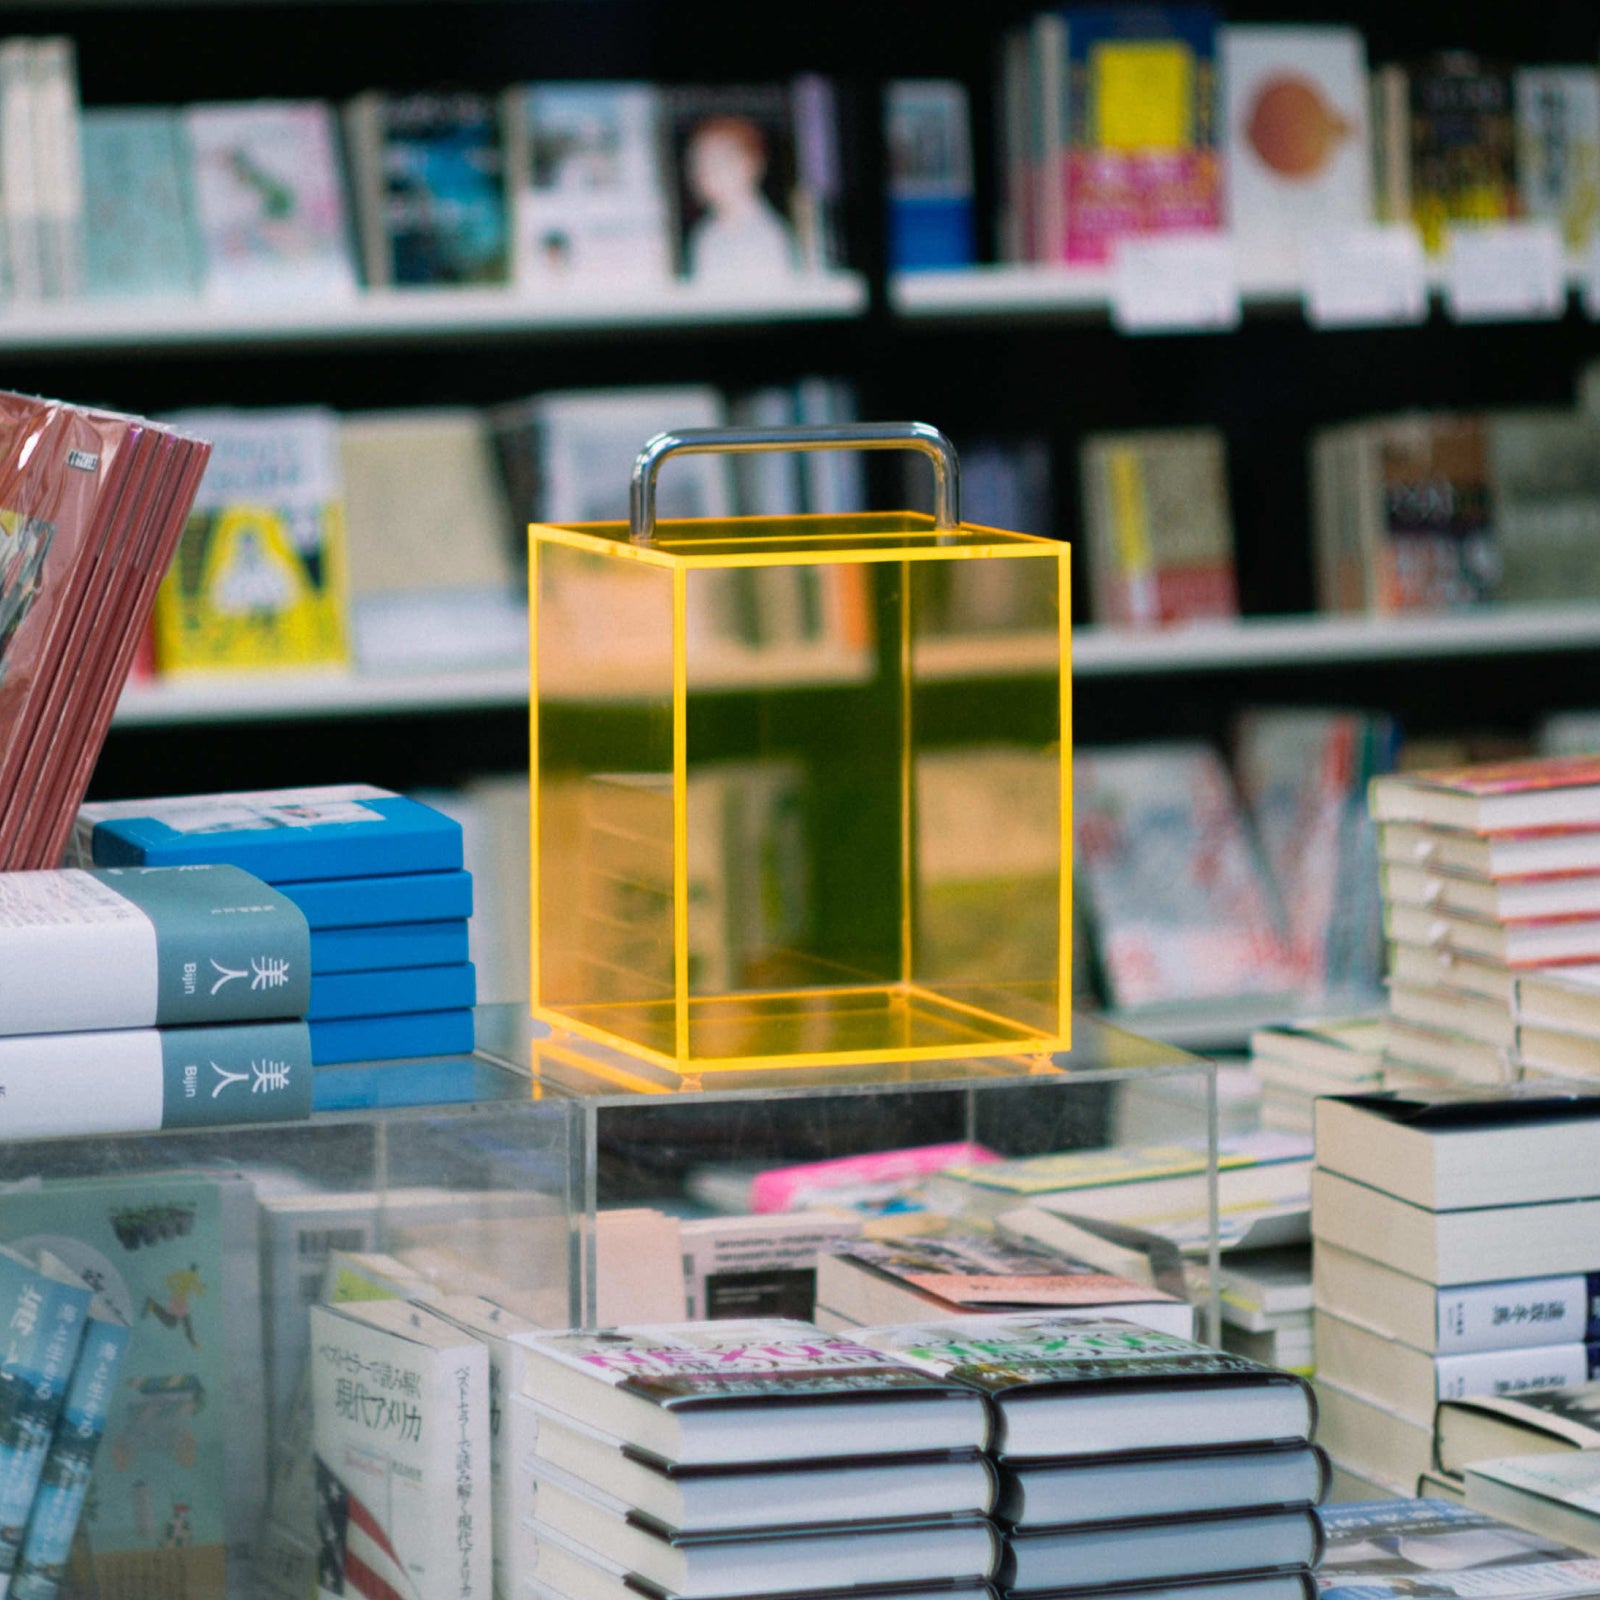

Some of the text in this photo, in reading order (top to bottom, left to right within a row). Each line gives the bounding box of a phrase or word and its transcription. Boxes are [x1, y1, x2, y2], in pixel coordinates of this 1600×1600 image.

[182, 962, 197, 995] Bijin
[210, 955, 289, 995] 美人
[182, 1065, 198, 1098] Bijin
[210, 1058, 290, 1098] 美人
[334, 1377, 421, 1443] 現代アメリカ
